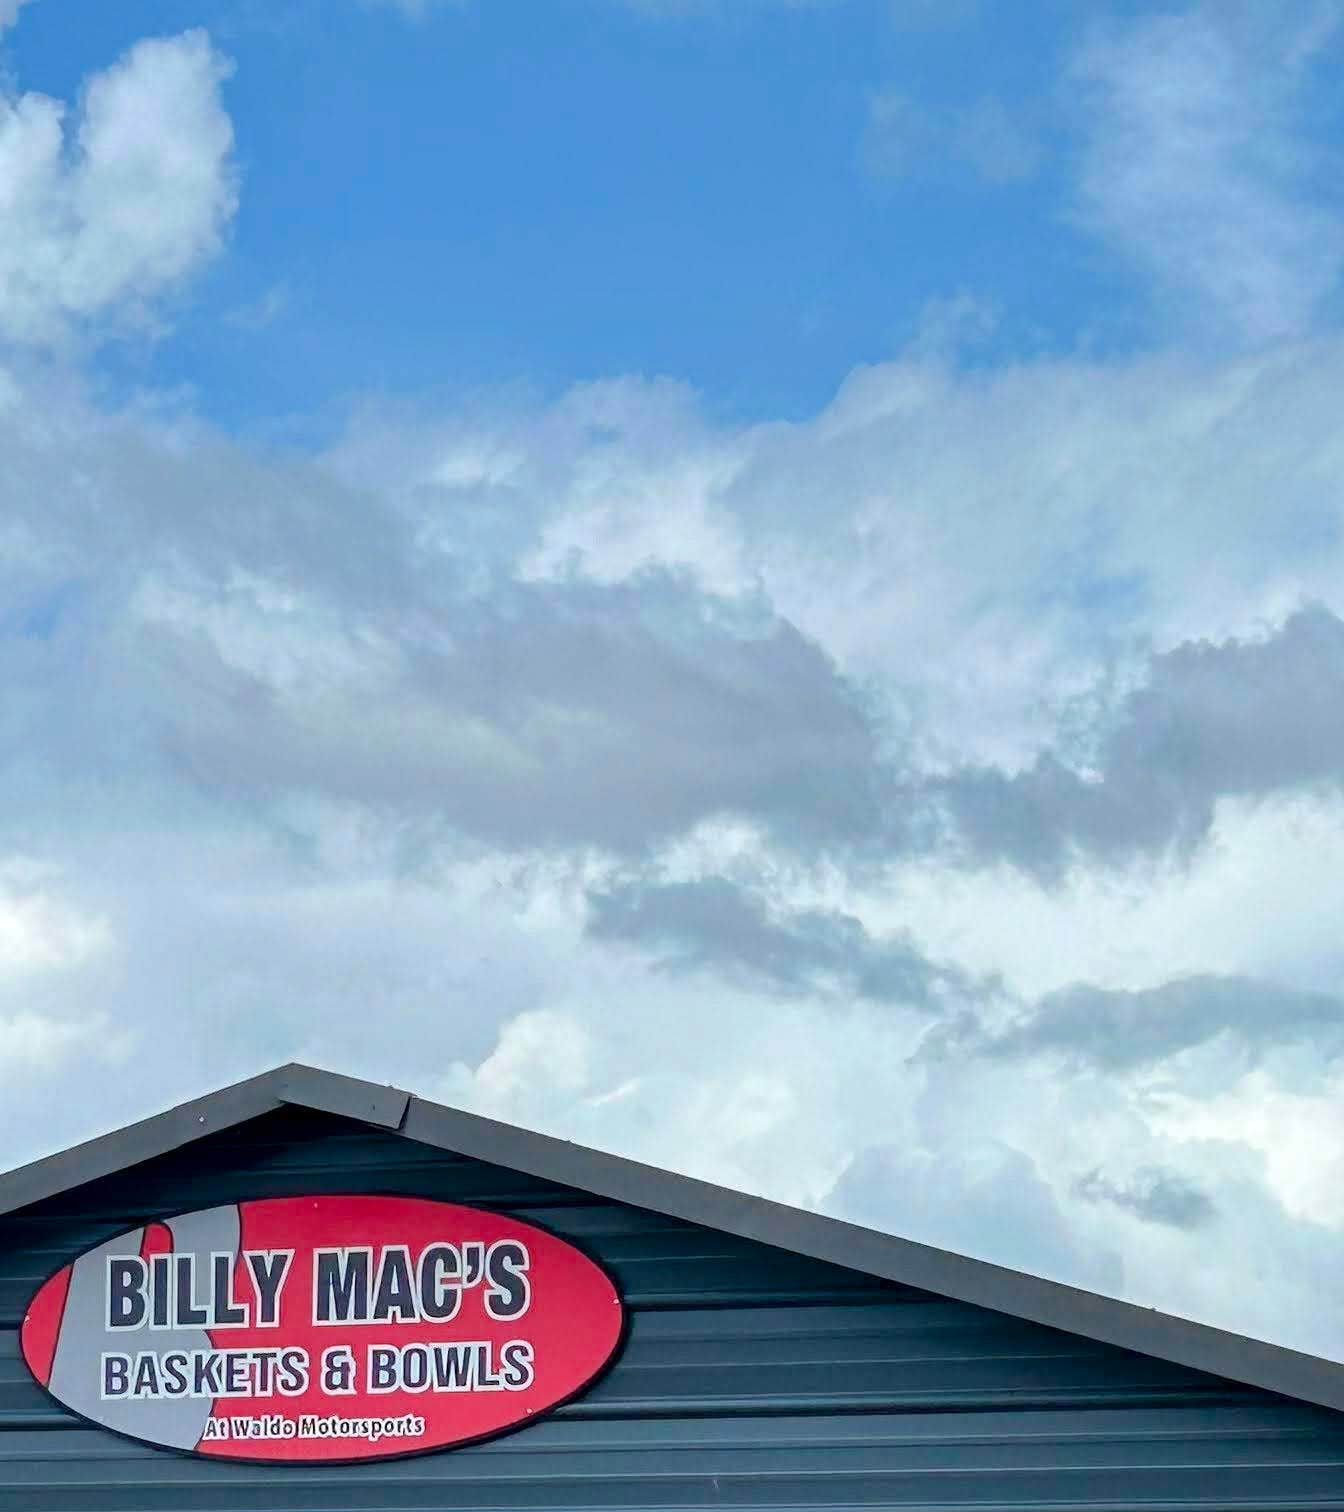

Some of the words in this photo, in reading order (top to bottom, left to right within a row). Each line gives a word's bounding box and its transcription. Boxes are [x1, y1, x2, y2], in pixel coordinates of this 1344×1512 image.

[107, 1250, 293, 1329] BILLY
[314, 1241, 530, 1325] MAC'S
[103, 1349, 308, 1398] BASKETS
[322, 1347, 355, 1394] &
[369, 1341, 533, 1392] BOWLS
[204, 1417, 227, 1438] At
[232, 1416, 295, 1437] Waldo
[299, 1415, 424, 1439] Motorsports
